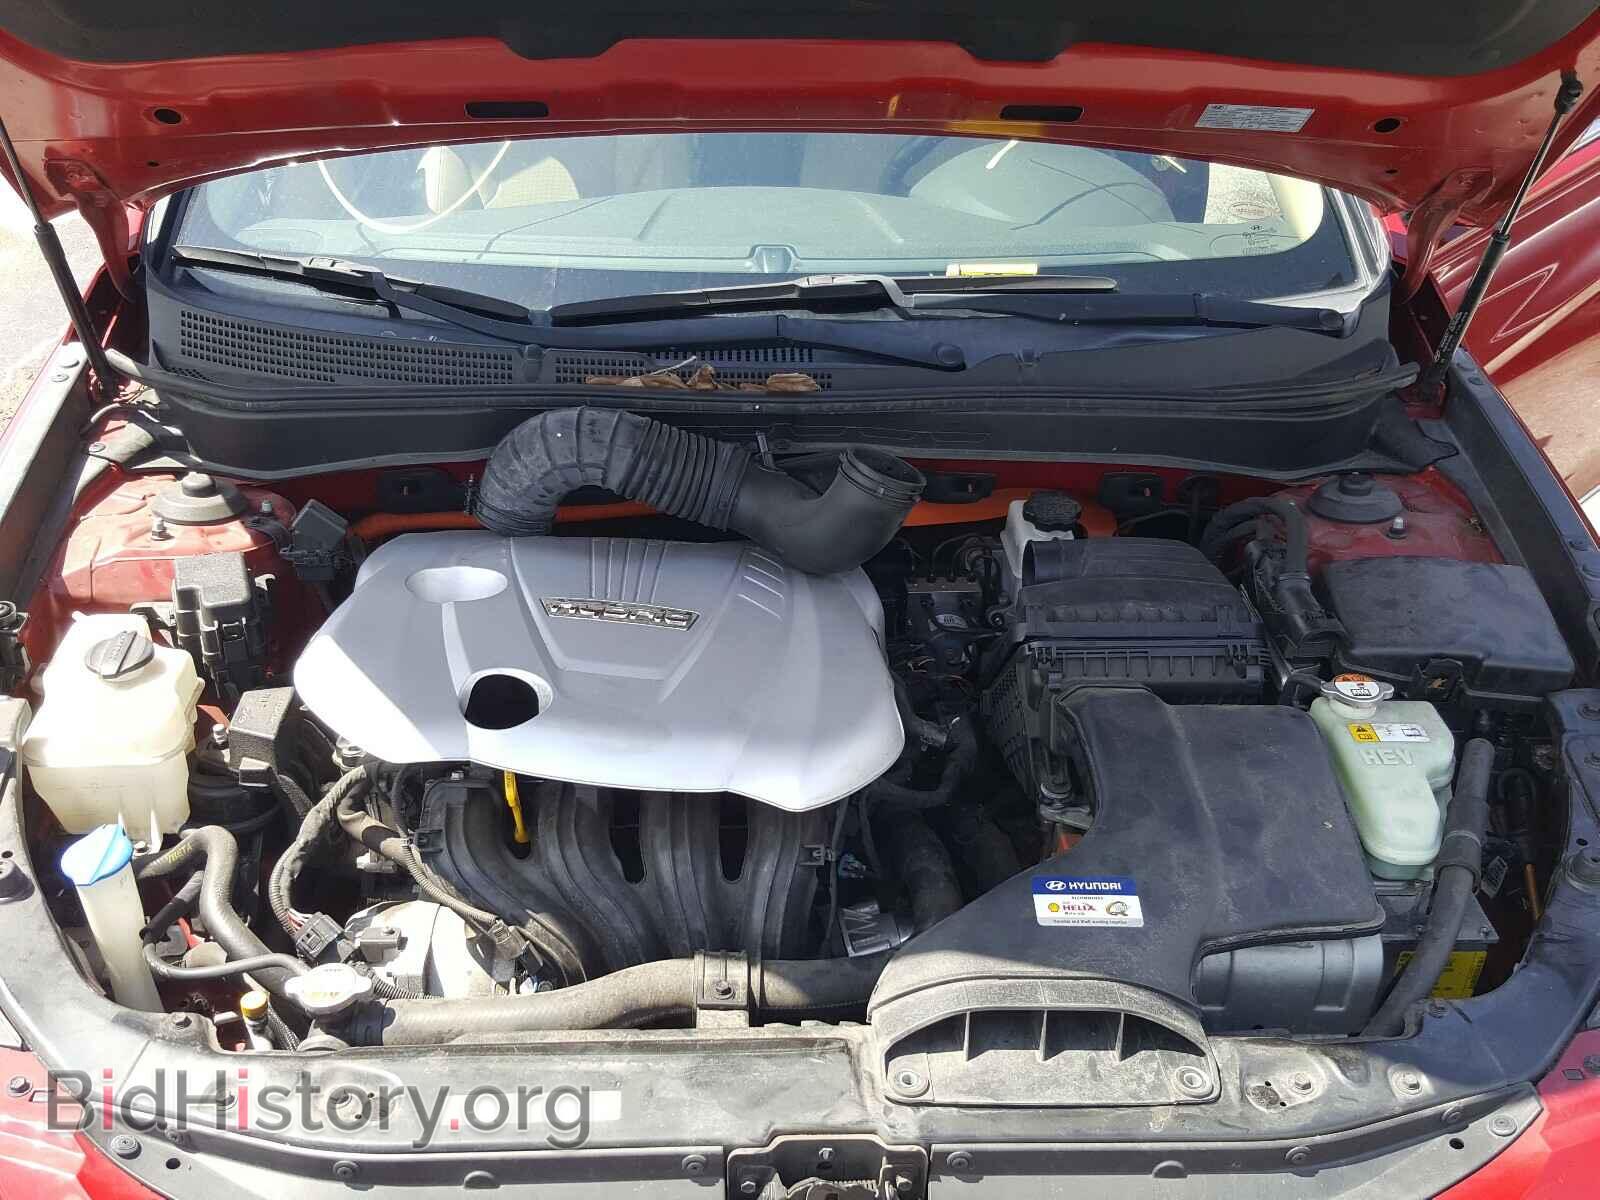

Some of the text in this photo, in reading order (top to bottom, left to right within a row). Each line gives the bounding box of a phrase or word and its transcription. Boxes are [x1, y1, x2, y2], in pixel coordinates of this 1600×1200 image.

[1360, 748, 1415, 767] HEV
[1067, 881, 1123, 890] HYUNDAI
[1062, 903, 1096, 911] HELIX
